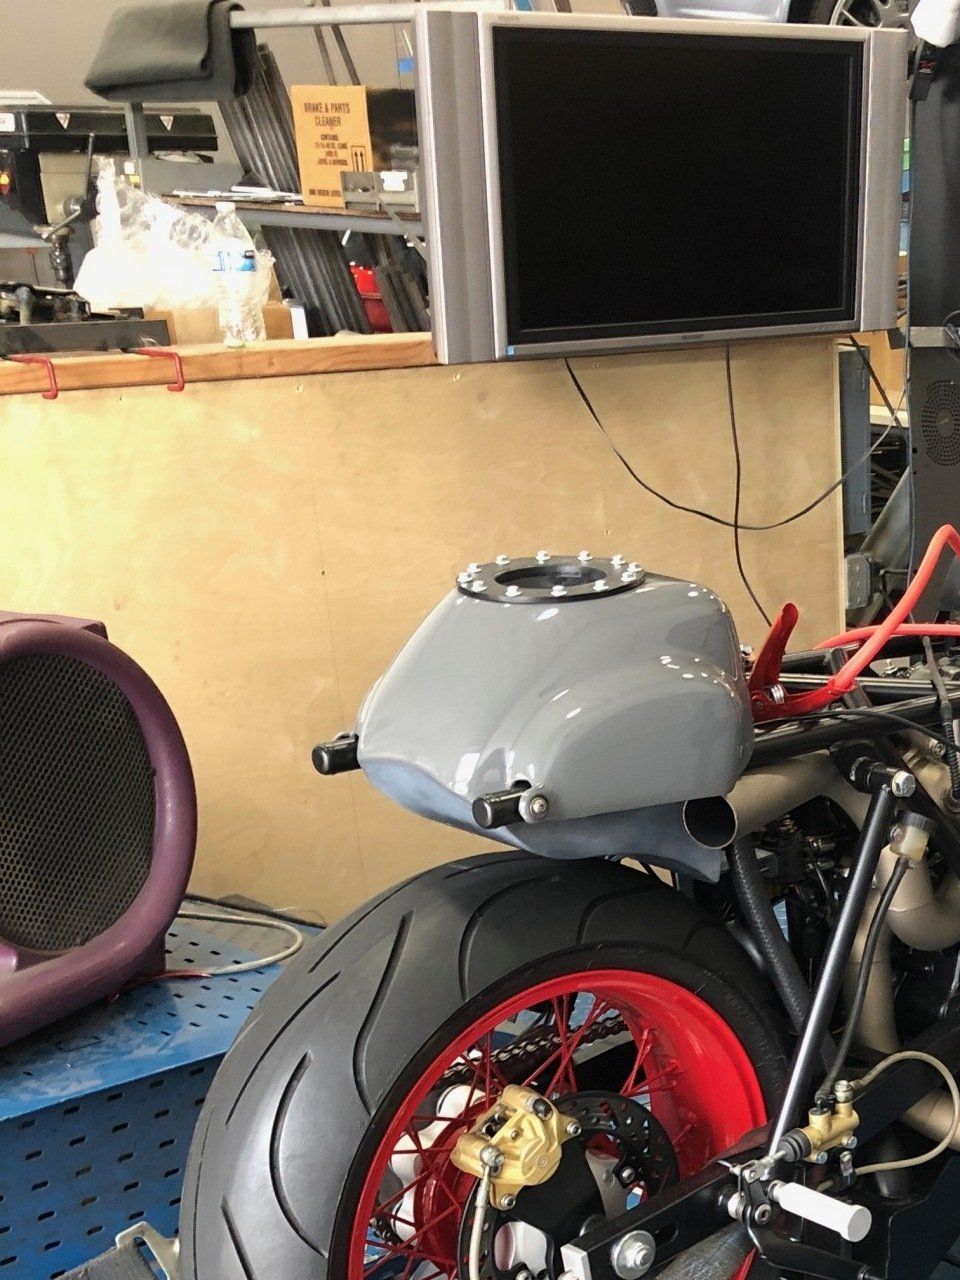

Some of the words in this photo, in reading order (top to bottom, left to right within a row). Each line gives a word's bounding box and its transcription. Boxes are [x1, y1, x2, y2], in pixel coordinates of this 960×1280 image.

[303, 102, 323, 113] BRAKE
[324, 102, 330, 113] &
[330, 102, 351, 114] PARTS
[314, 116, 342, 127] CLEANER
